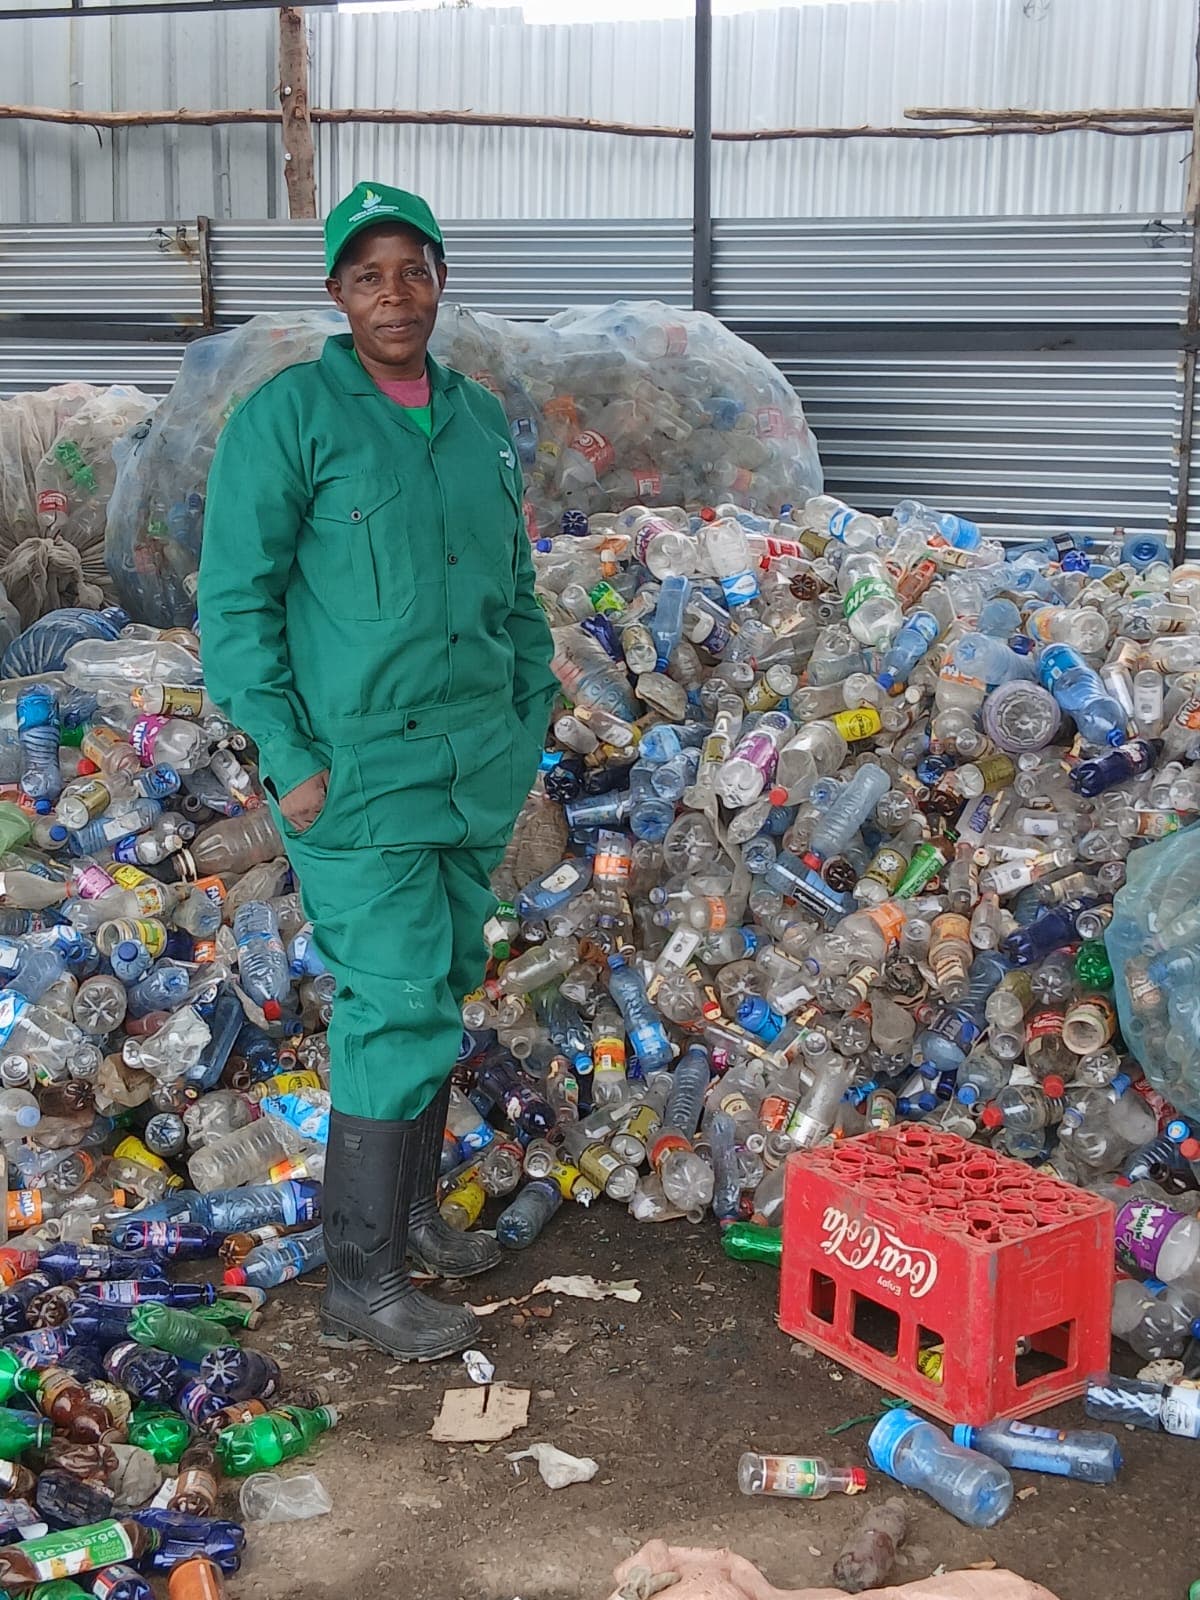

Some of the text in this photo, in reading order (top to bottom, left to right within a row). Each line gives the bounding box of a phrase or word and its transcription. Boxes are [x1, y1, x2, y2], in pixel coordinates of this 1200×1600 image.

[821, 1207, 938, 1298] Coca-Cola
[877, 1275, 902, 1297] Enjoy
[34, 1529, 118, 1561] Re-Charge
